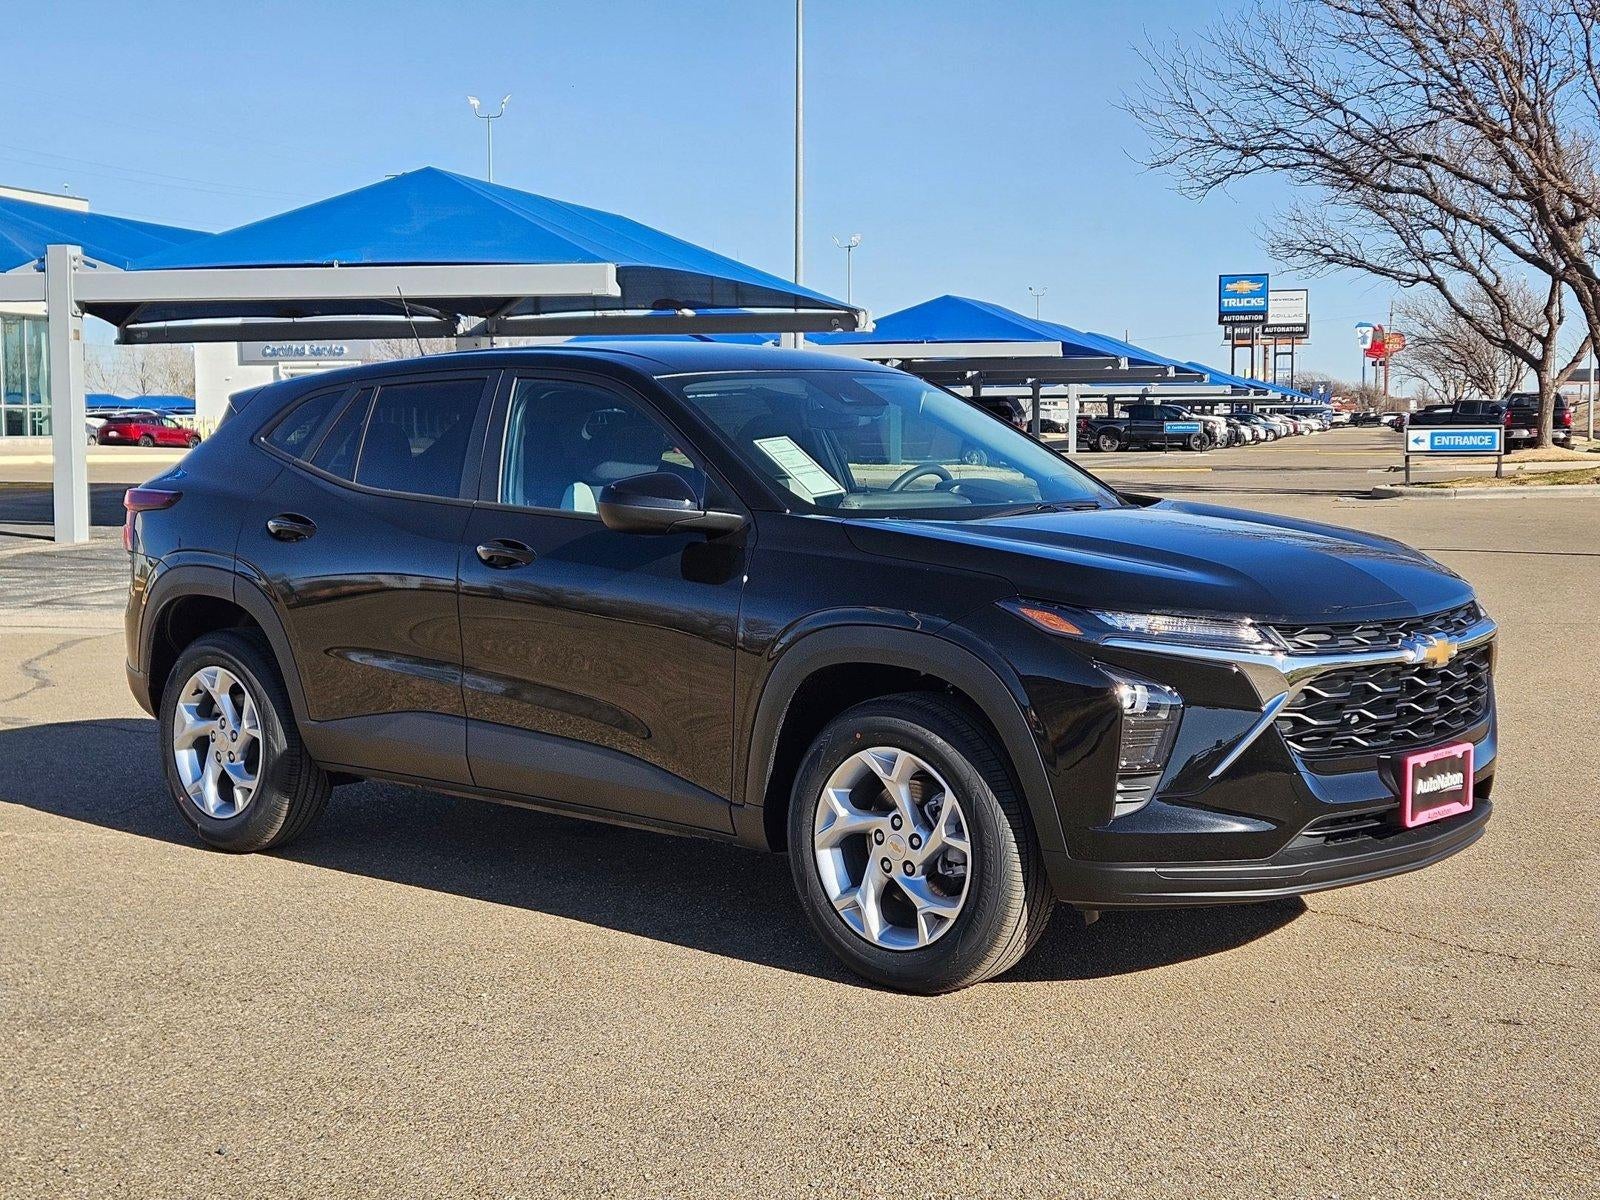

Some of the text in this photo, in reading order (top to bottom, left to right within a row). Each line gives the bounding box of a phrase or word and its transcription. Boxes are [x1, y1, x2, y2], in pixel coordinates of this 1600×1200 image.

[1222, 297, 1265, 307] TRUCKS
[261, 344, 345, 357] Certified Service
[1434, 435, 1493, 446] ENTRANCE
[1416, 772, 1464, 795] AutoNation
